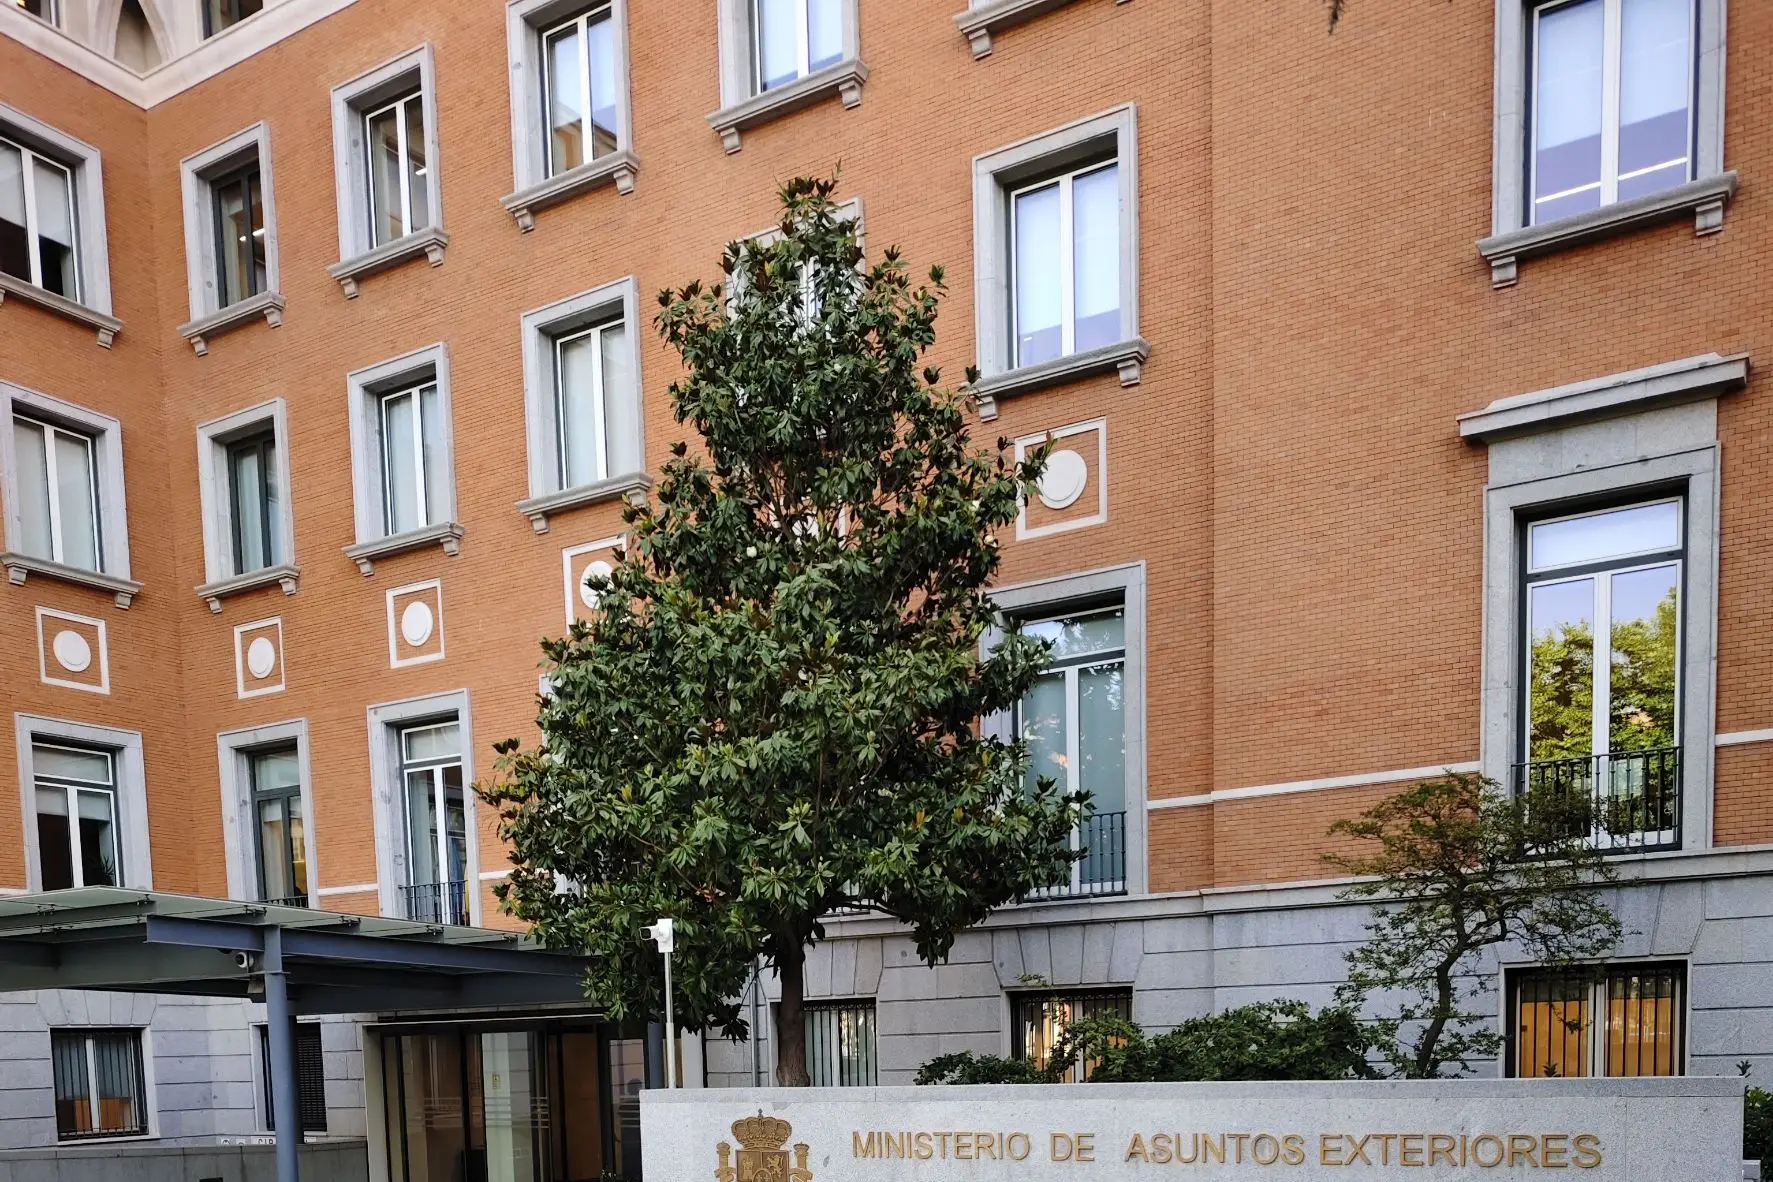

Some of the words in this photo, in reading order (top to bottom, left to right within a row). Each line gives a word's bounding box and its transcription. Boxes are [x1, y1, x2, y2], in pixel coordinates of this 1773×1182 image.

[853, 1131, 1031, 1160] MINISTERIO
[1049, 1132, 1095, 1162] DE
[1124, 1133, 1305, 1165] ASUNTOS
[1319, 1134, 1603, 1168] EXTERIORES
